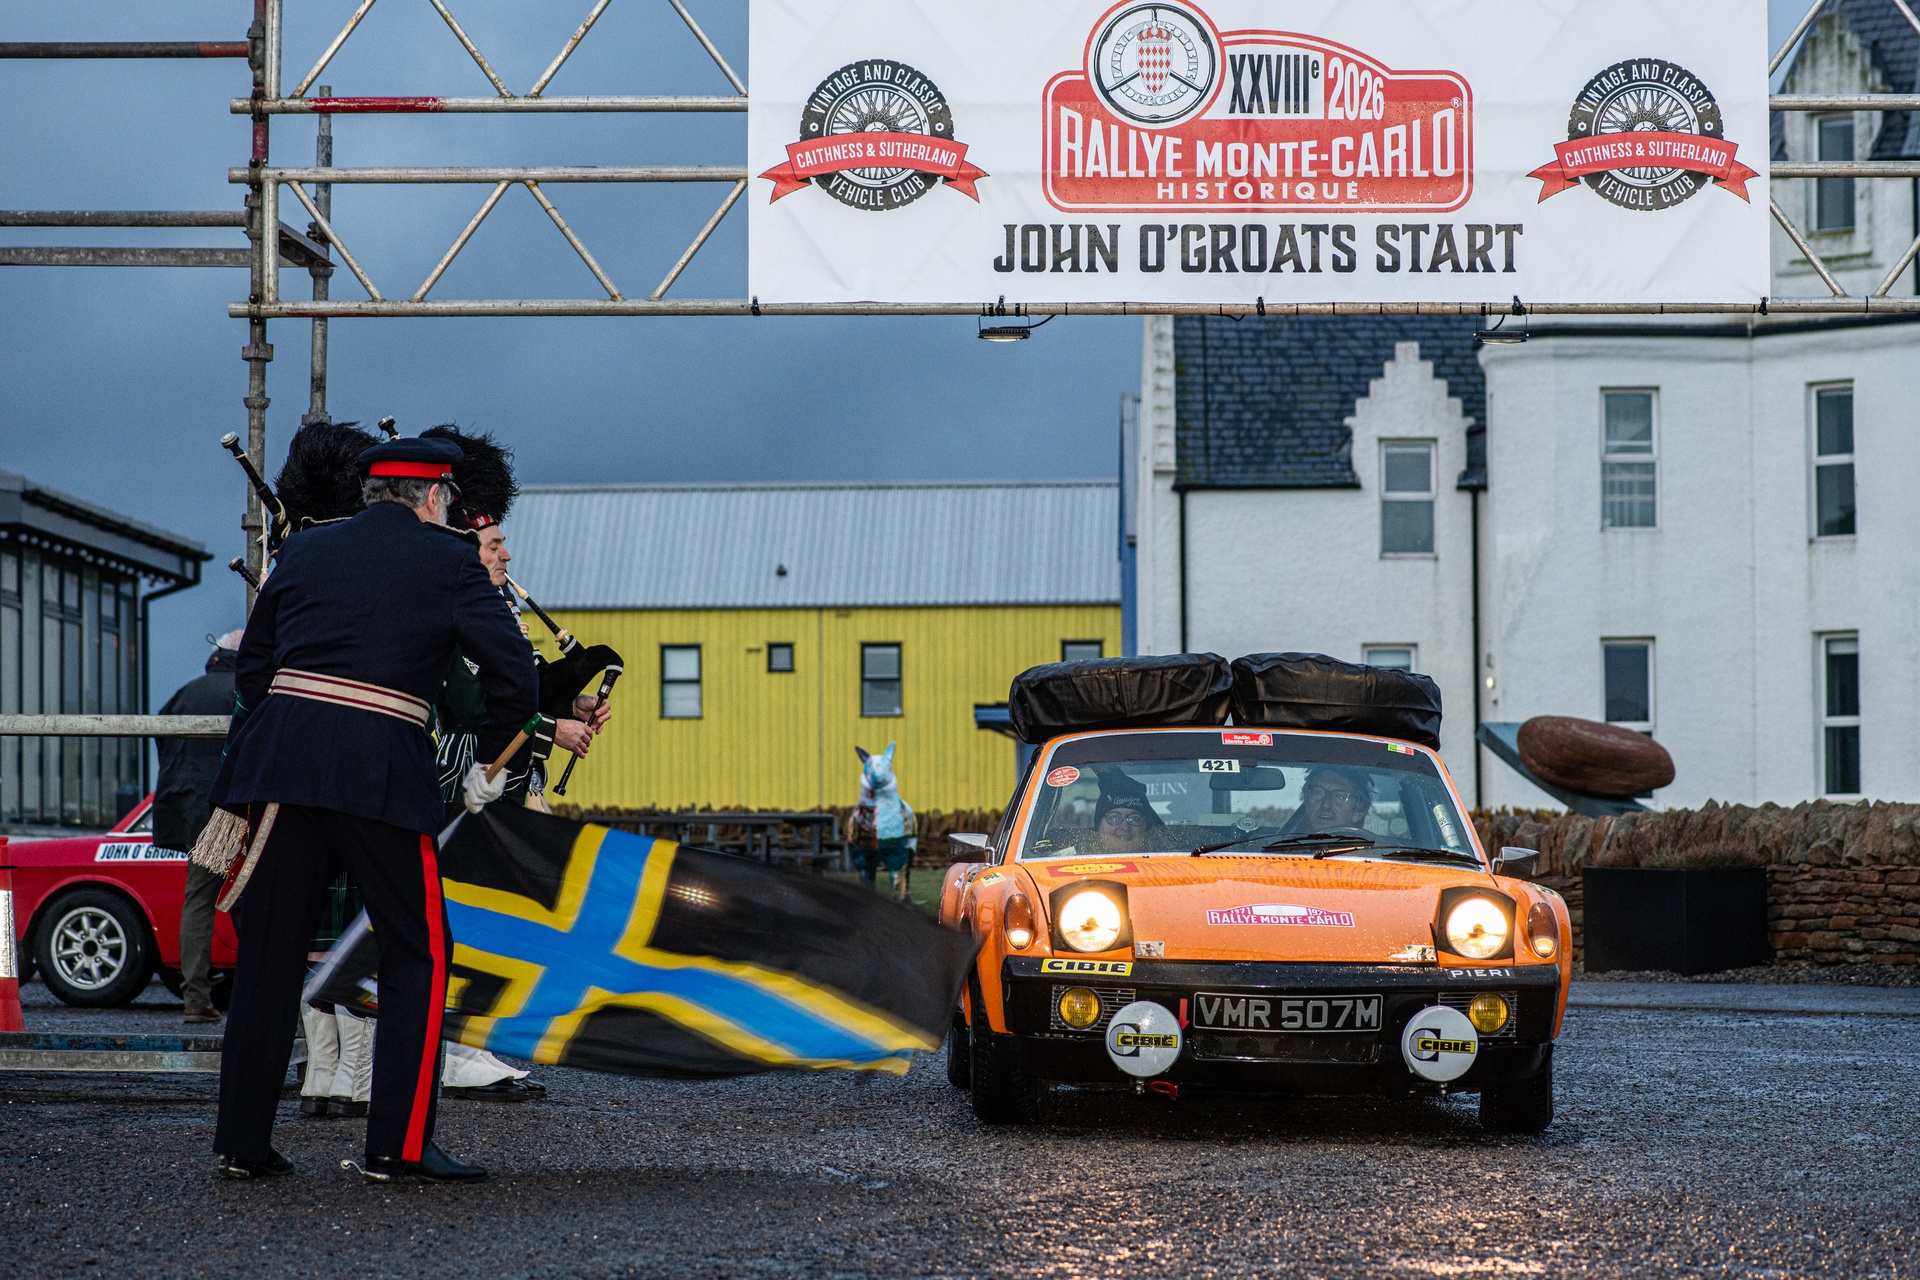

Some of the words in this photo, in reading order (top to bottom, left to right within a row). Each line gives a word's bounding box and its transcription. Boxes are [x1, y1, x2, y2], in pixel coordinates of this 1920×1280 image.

[810, 68, 861, 115] VINTAGE
[864, 64, 892, 81] AND
[895, 68, 943, 114] CLASSIC
[1327, 57, 1384, 121] 2026
[1578, 67, 1629, 113] VINTAGE
[1631, 63, 1660, 80] AND
[1662, 67, 1712, 113] CLASSIC
[796, 142, 863, 168] CAITHNESS
[866, 143, 876, 157] &
[879, 141, 957, 168] SUTHERLAND
[1060, 105, 1182, 178] RALLYE
[1564, 142, 1632, 167] CAITHNESS
[1635, 142, 1645, 156] &
[1648, 141, 1727, 167] SUTHERLAND
[828, 174, 884, 206] VEHICLE
[890, 175, 925, 203] CLUB
[1157, 181, 1358, 200] HISTORIQUE
[1597, 174, 1653, 206] VEHICLE
[1660, 175, 1695, 203] CLUB
[994, 224, 1121, 273] JOHN
[1139, 224, 1357, 273] O'GROATS
[1375, 224, 1523, 274] START
[1202, 760, 1233, 771] 421
[100, 844, 131, 859] JOHN
[1210, 911, 1258, 924] RALLYE
[1451, 968, 1511, 978] PIERI
[1199, 997, 1271, 1028] VMR
[1281, 998, 1379, 1028] 507M
